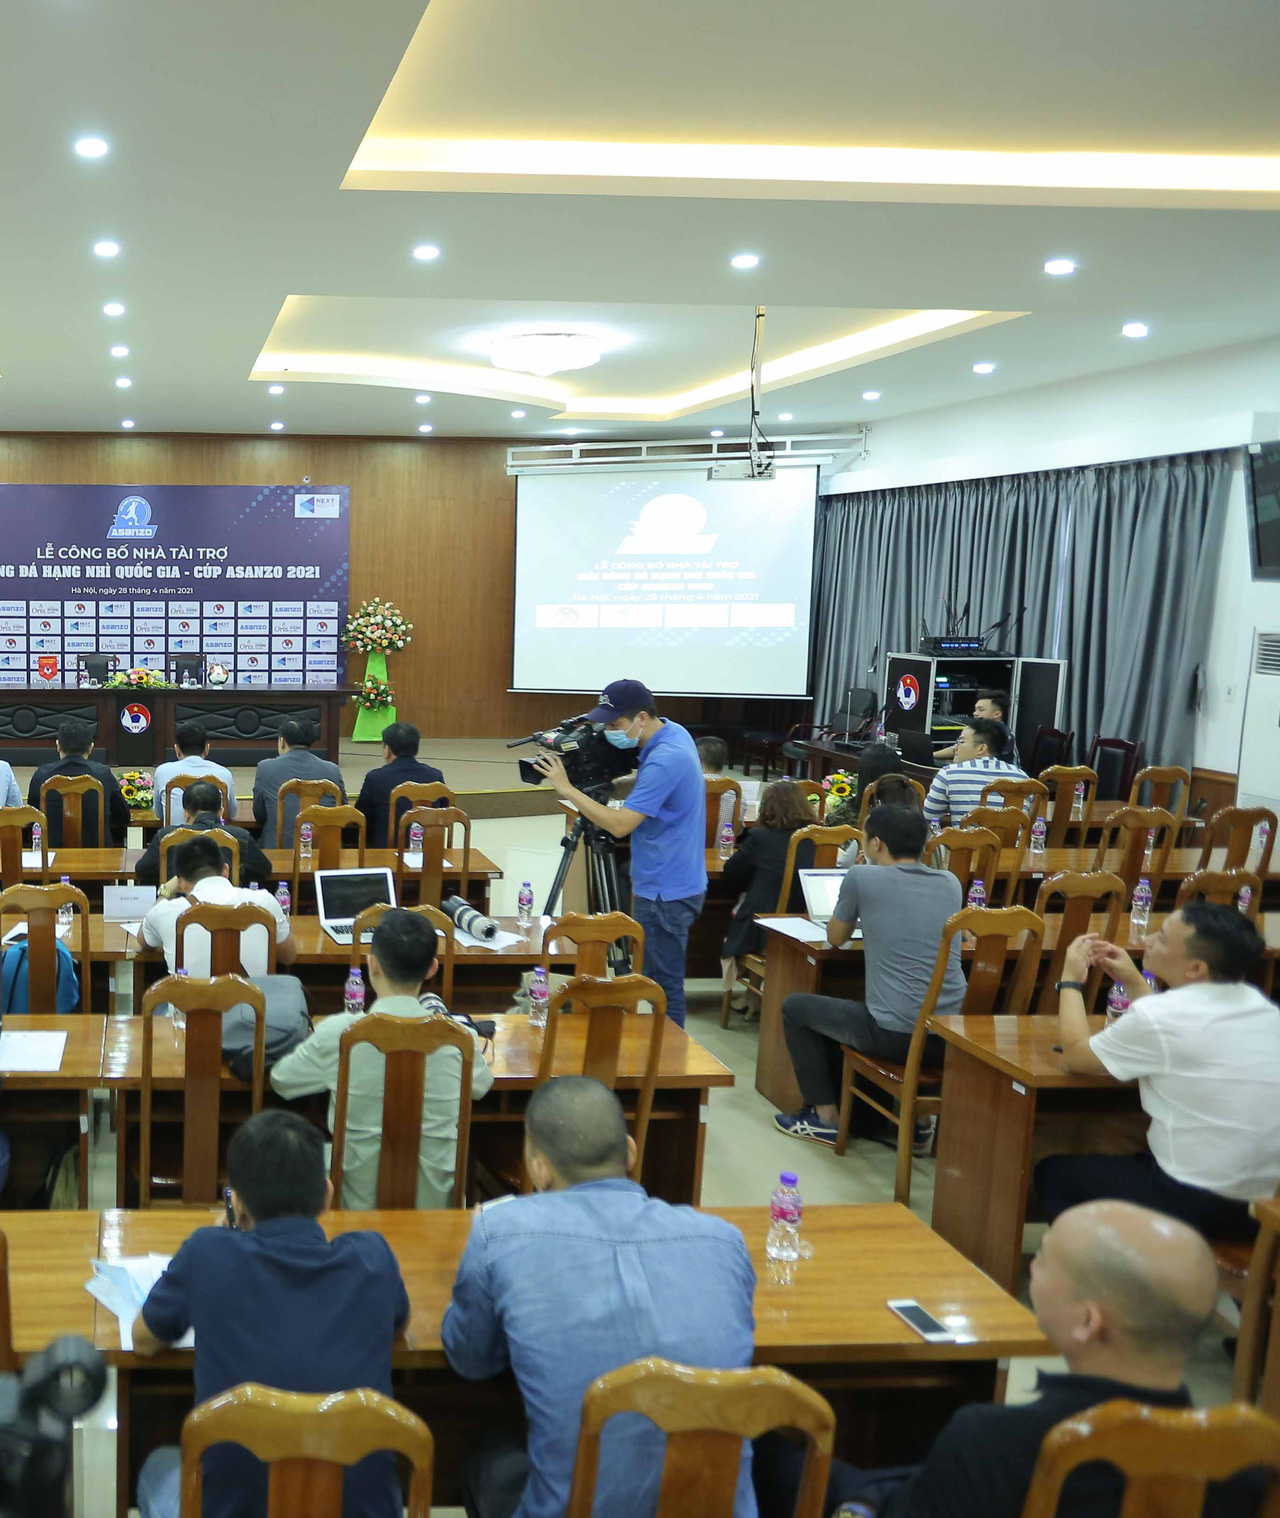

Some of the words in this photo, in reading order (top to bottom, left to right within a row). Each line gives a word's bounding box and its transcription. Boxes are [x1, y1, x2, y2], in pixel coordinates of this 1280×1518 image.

[37, 543, 54, 559] LỄ
[58, 545, 102, 559] CÔNG
[107, 544, 129, 559] BỐ
[133, 546, 165, 560] NHÀ
[169, 546, 193, 560] TÀI
[197, 546, 228, 562] TRỢ
[19, 562, 38, 578] ĐÁ
[42, 565, 81, 581] HẠNG
[85, 562, 111, 578] NHÌ
[115, 561, 152, 579] QUỐC
[157, 566, 180, 578] GIA
[194, 562, 221, 578] CÚP
[226, 566, 283, 579] ASANZO
[287, 566, 320, 579] 2021
[83, 587, 97, 595] Nội,
[129, 587, 150, 595] tháng
